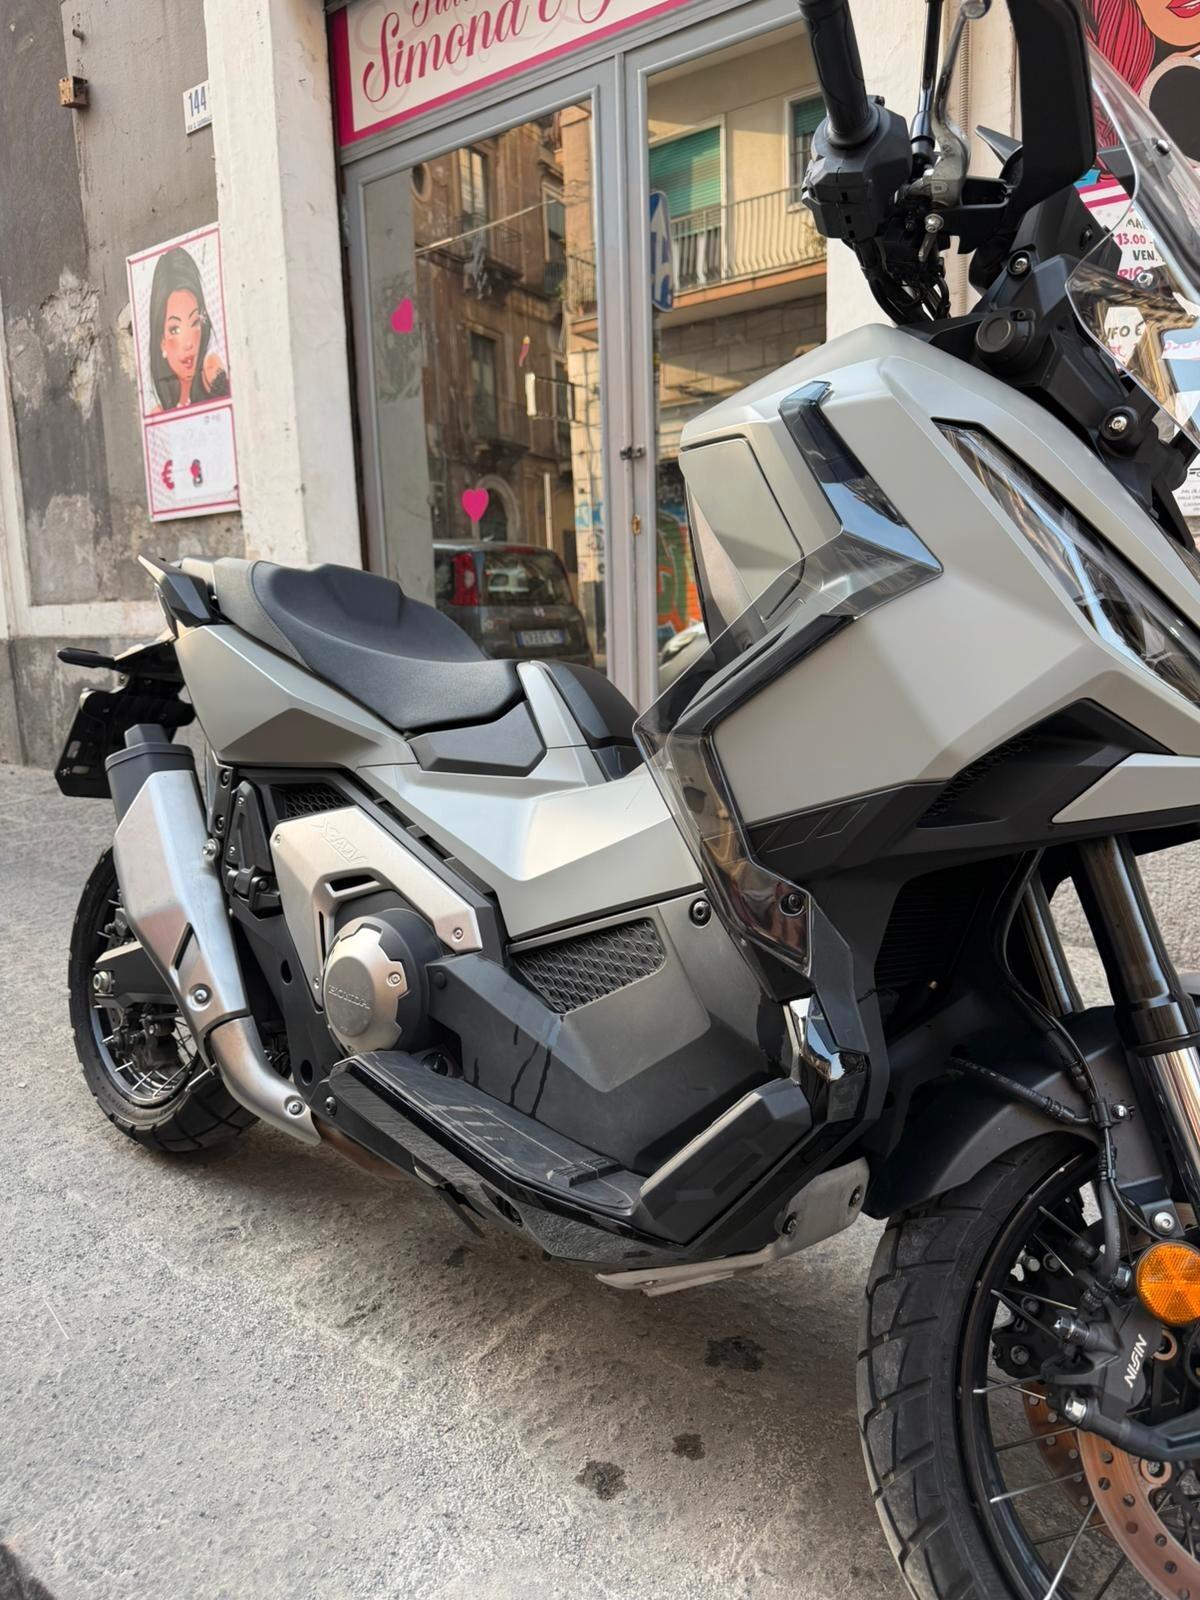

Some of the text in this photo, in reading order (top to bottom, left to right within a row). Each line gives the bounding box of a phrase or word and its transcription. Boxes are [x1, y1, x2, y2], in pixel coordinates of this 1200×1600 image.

[363, 12, 529, 103] Simona
[188, 86, 206, 117] 144
[1132, 249, 1158, 262] VEN.
